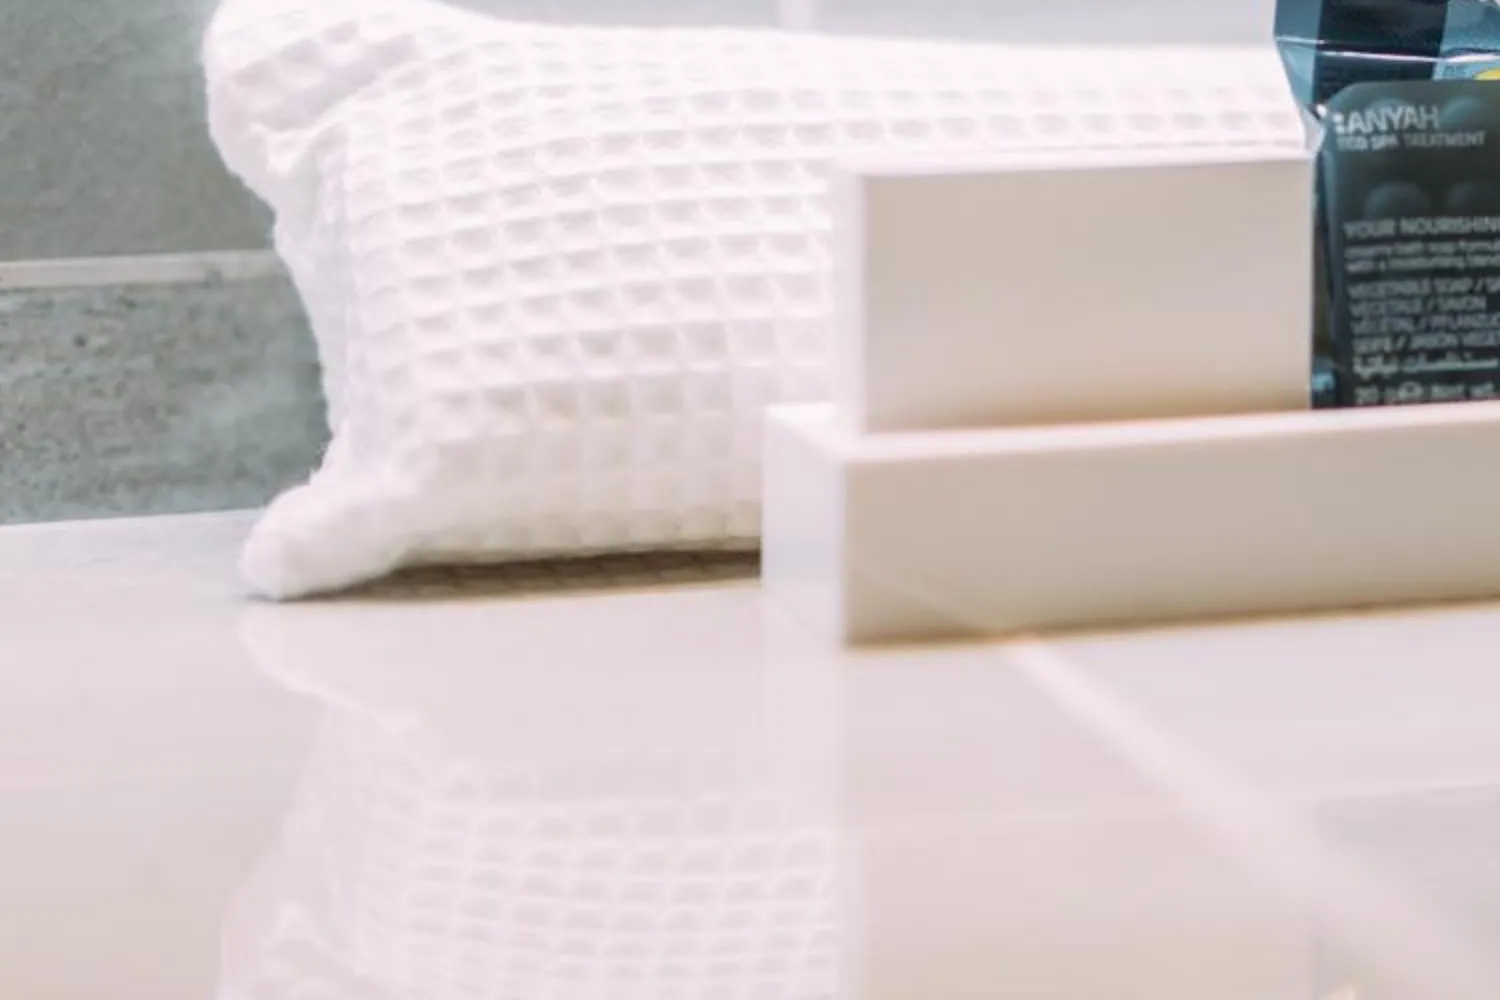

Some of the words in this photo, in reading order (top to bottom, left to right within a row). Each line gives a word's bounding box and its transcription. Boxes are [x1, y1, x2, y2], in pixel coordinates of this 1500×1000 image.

[1370, 134, 1398, 151] SPA
[1403, 130, 1486, 147] TREATMENT
[1344, 219, 1395, 237] YOUR
[1434, 278, 1473, 295] SOAP
